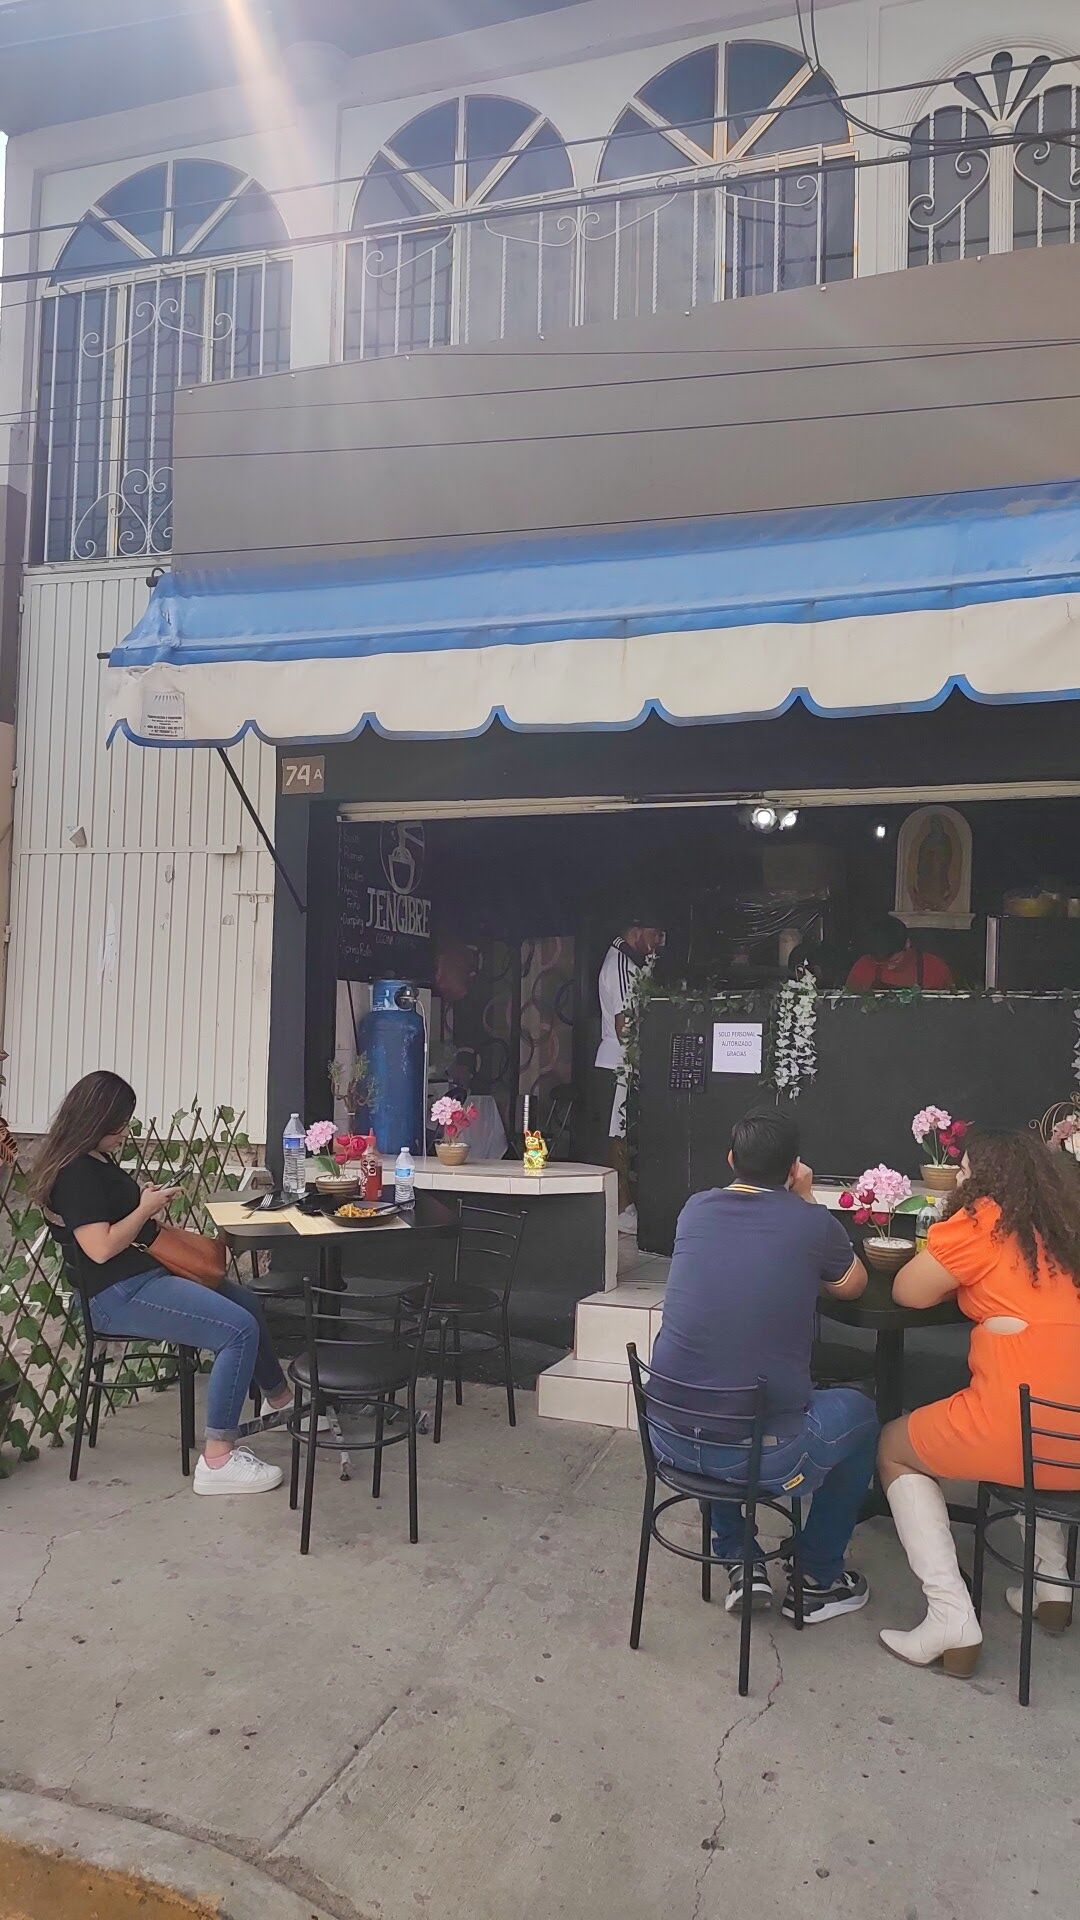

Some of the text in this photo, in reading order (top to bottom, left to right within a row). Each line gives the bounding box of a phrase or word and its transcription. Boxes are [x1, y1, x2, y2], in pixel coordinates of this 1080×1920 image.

[286, 765, 323, 786] 74 A
[366, 887, 431, 938] JENGIBRE
